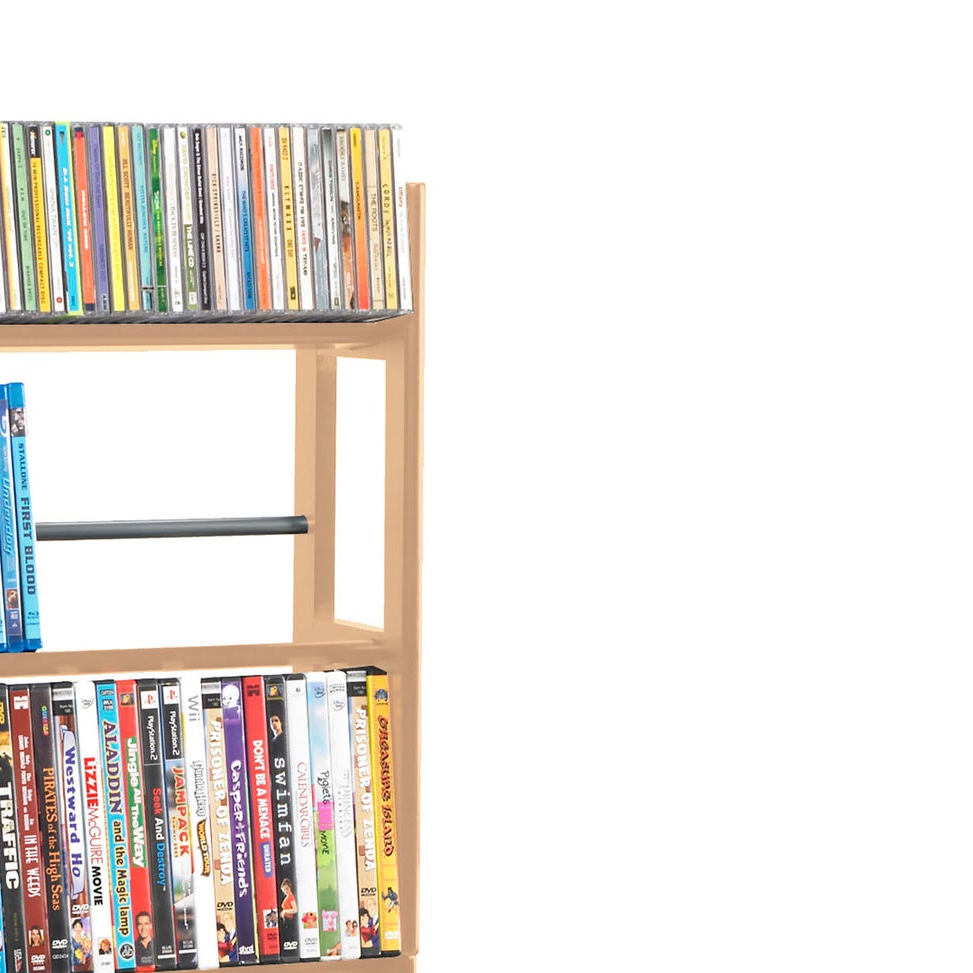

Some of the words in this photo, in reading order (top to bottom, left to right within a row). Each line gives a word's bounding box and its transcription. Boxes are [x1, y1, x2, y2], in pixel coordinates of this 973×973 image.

[33, 182, 41, 224] PROFESSIONAL
[1, 477, 14, 556] Underdog
[187, 695, 200, 722] Wii
[126, 737, 140, 787] Jingle
[209, 720, 228, 801] PRISONER
[252, 739, 267, 771] DON'T
[355, 706, 372, 787] PRISONER
[103, 720, 122, 814] ALADDIN
[255, 773, 267, 787] BE
[43, 767, 58, 822] PIRATES
[64, 746, 80, 844] Westward
[132, 788, 143, 804] All
[256, 788, 268, 797] A
[296, 761, 309, 819] CALENDAR
[360, 792, 374, 813] OF
[130, 804, 141, 827] The
[173, 767, 189, 857] JAMPACK
[215, 805, 229, 827] OF
[256, 798, 272, 839] MENACE
[274, 757, 292, 866] swimfan
[24, 835, 37, 844] IN
[46, 823, 57, 834] of
[48, 835, 57, 850] the
[112, 820, 125, 843] and
[299, 818, 311, 849] GIRLS
[24, 845, 39, 865] THE
[115, 846, 127, 865] the
[131, 826, 146, 868] Way
[218, 833, 234, 886] ZENDA
[363, 818, 376, 872] ZENDA
[47, 851, 61, 882] High
[70, 853, 83, 878] Ho
[25, 866, 41, 898] WEEDS
[50, 884, 63, 911] Seas
[114, 869, 129, 904] Magic
[117, 906, 131, 936] lamp
